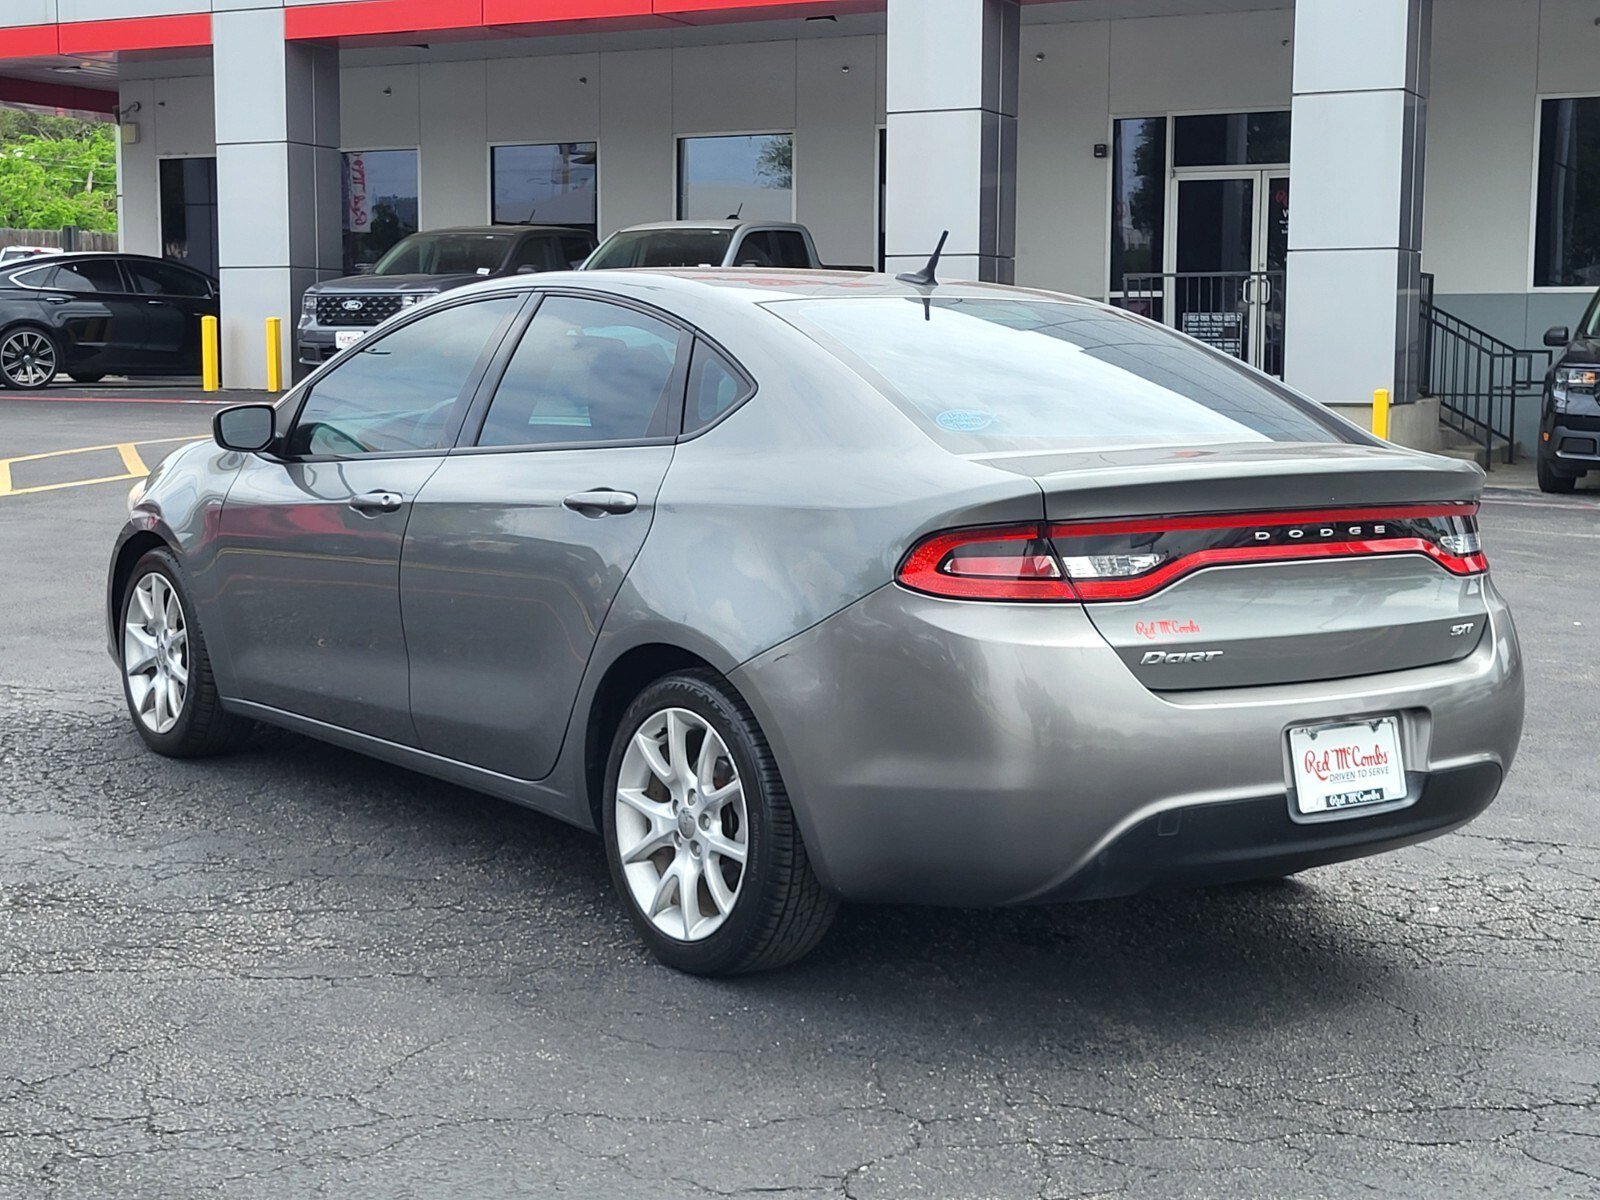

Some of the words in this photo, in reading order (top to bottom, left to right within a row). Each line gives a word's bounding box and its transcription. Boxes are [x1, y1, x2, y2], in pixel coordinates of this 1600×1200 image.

[1254, 525, 1386, 540] DODGE
[1135, 621, 1156, 639] Red
[1450, 622, 1474, 636] SXT
[1304, 750, 1330, 781] Red
[1330, 744, 1388, 770] McCombs
[1329, 771, 1355, 782] DRIVEN
[1357, 769, 1367, 778] TO
[1368, 766, 1389, 776] SERVE
[1329, 793, 1346, 808] Red
